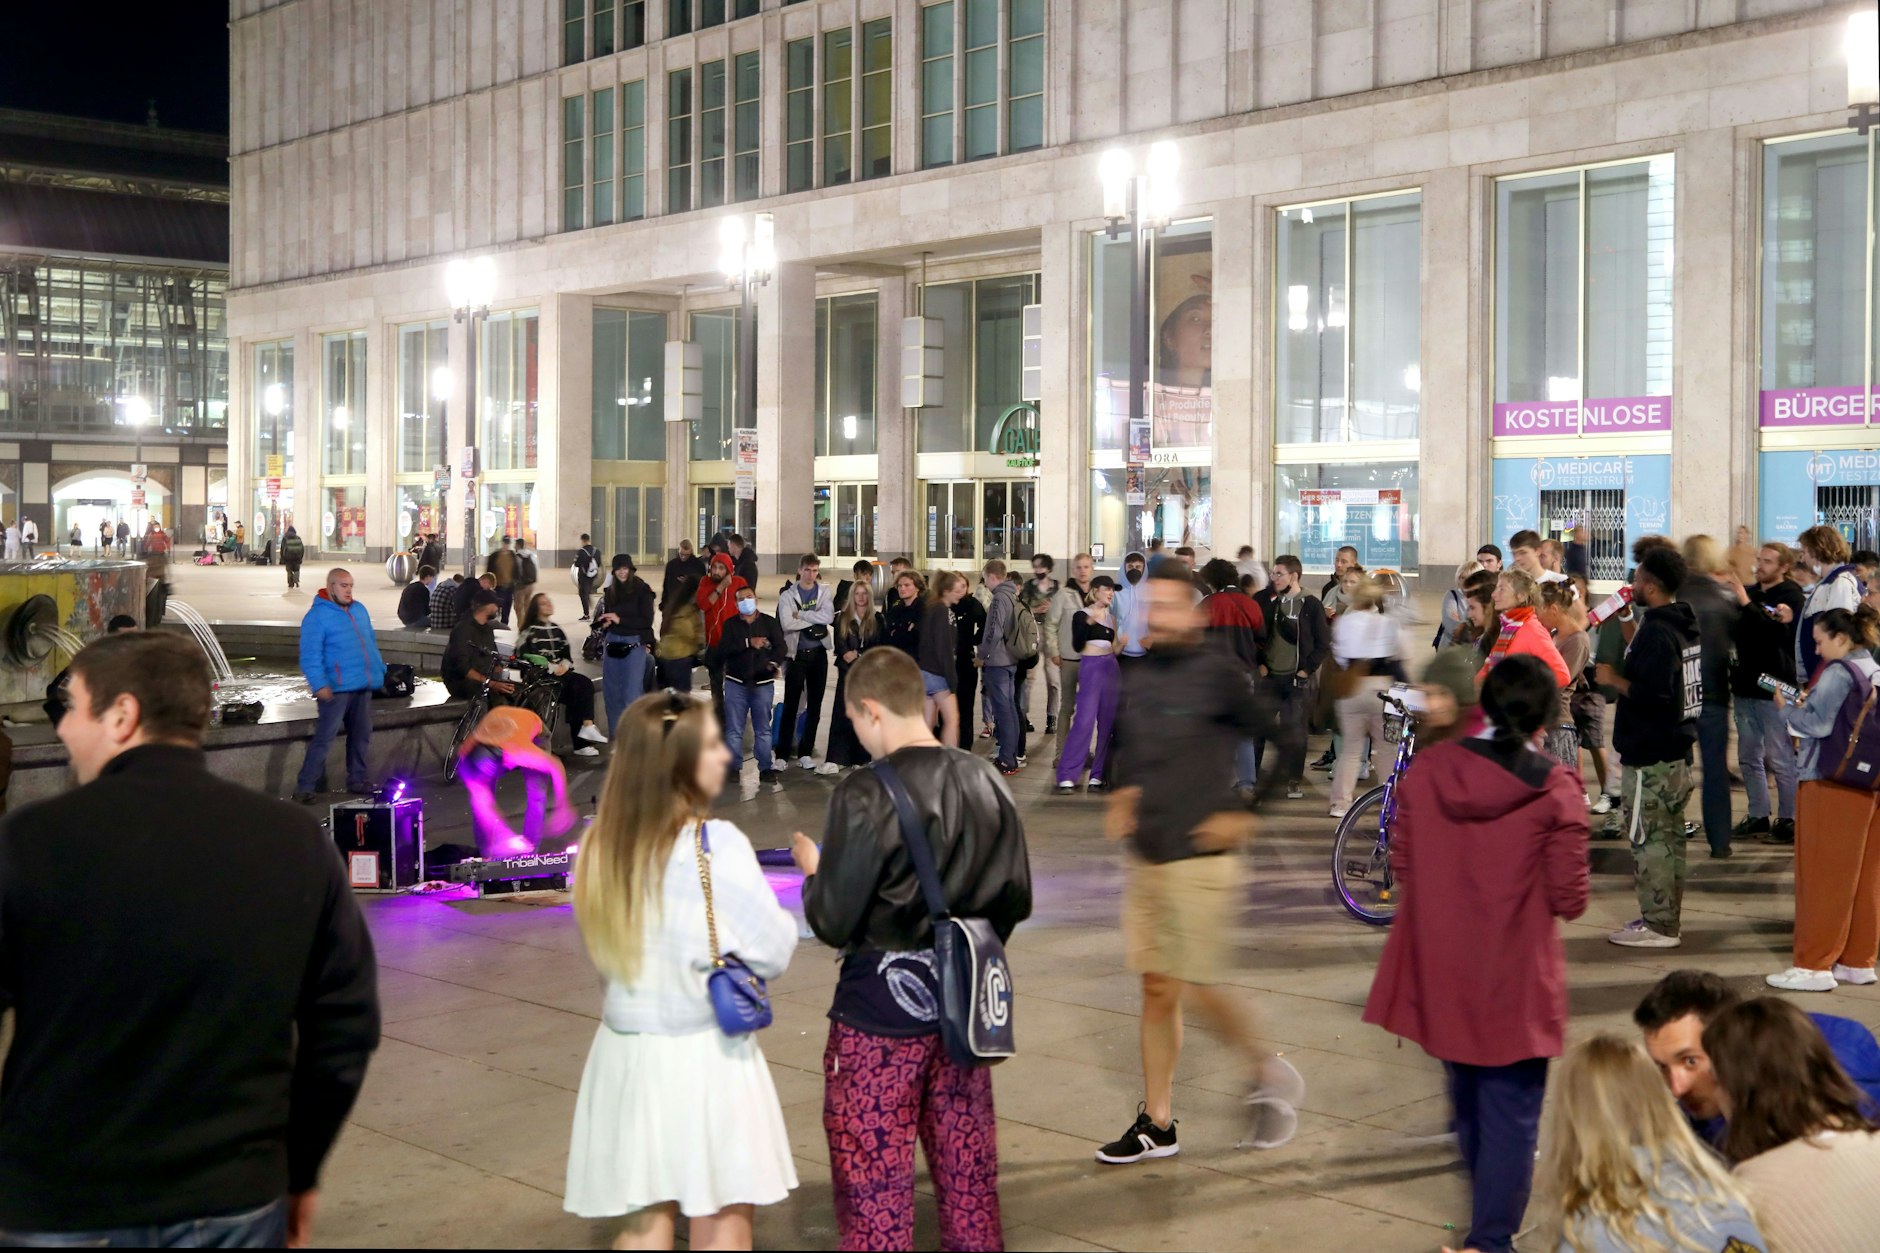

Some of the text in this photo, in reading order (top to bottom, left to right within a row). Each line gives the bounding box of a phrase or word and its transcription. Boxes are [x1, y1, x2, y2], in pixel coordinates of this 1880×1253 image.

[1505, 404, 1662, 430] KOSTENLOSE
[1557, 461, 1634, 475] MEDICARE
[1557, 475, 1634, 487] TESTZENTRUM
[1838, 470, 1880, 481] TESTZ
[1763, 675, 1797, 695] BERLNER
[502, 854, 569, 869] TribalNeed
